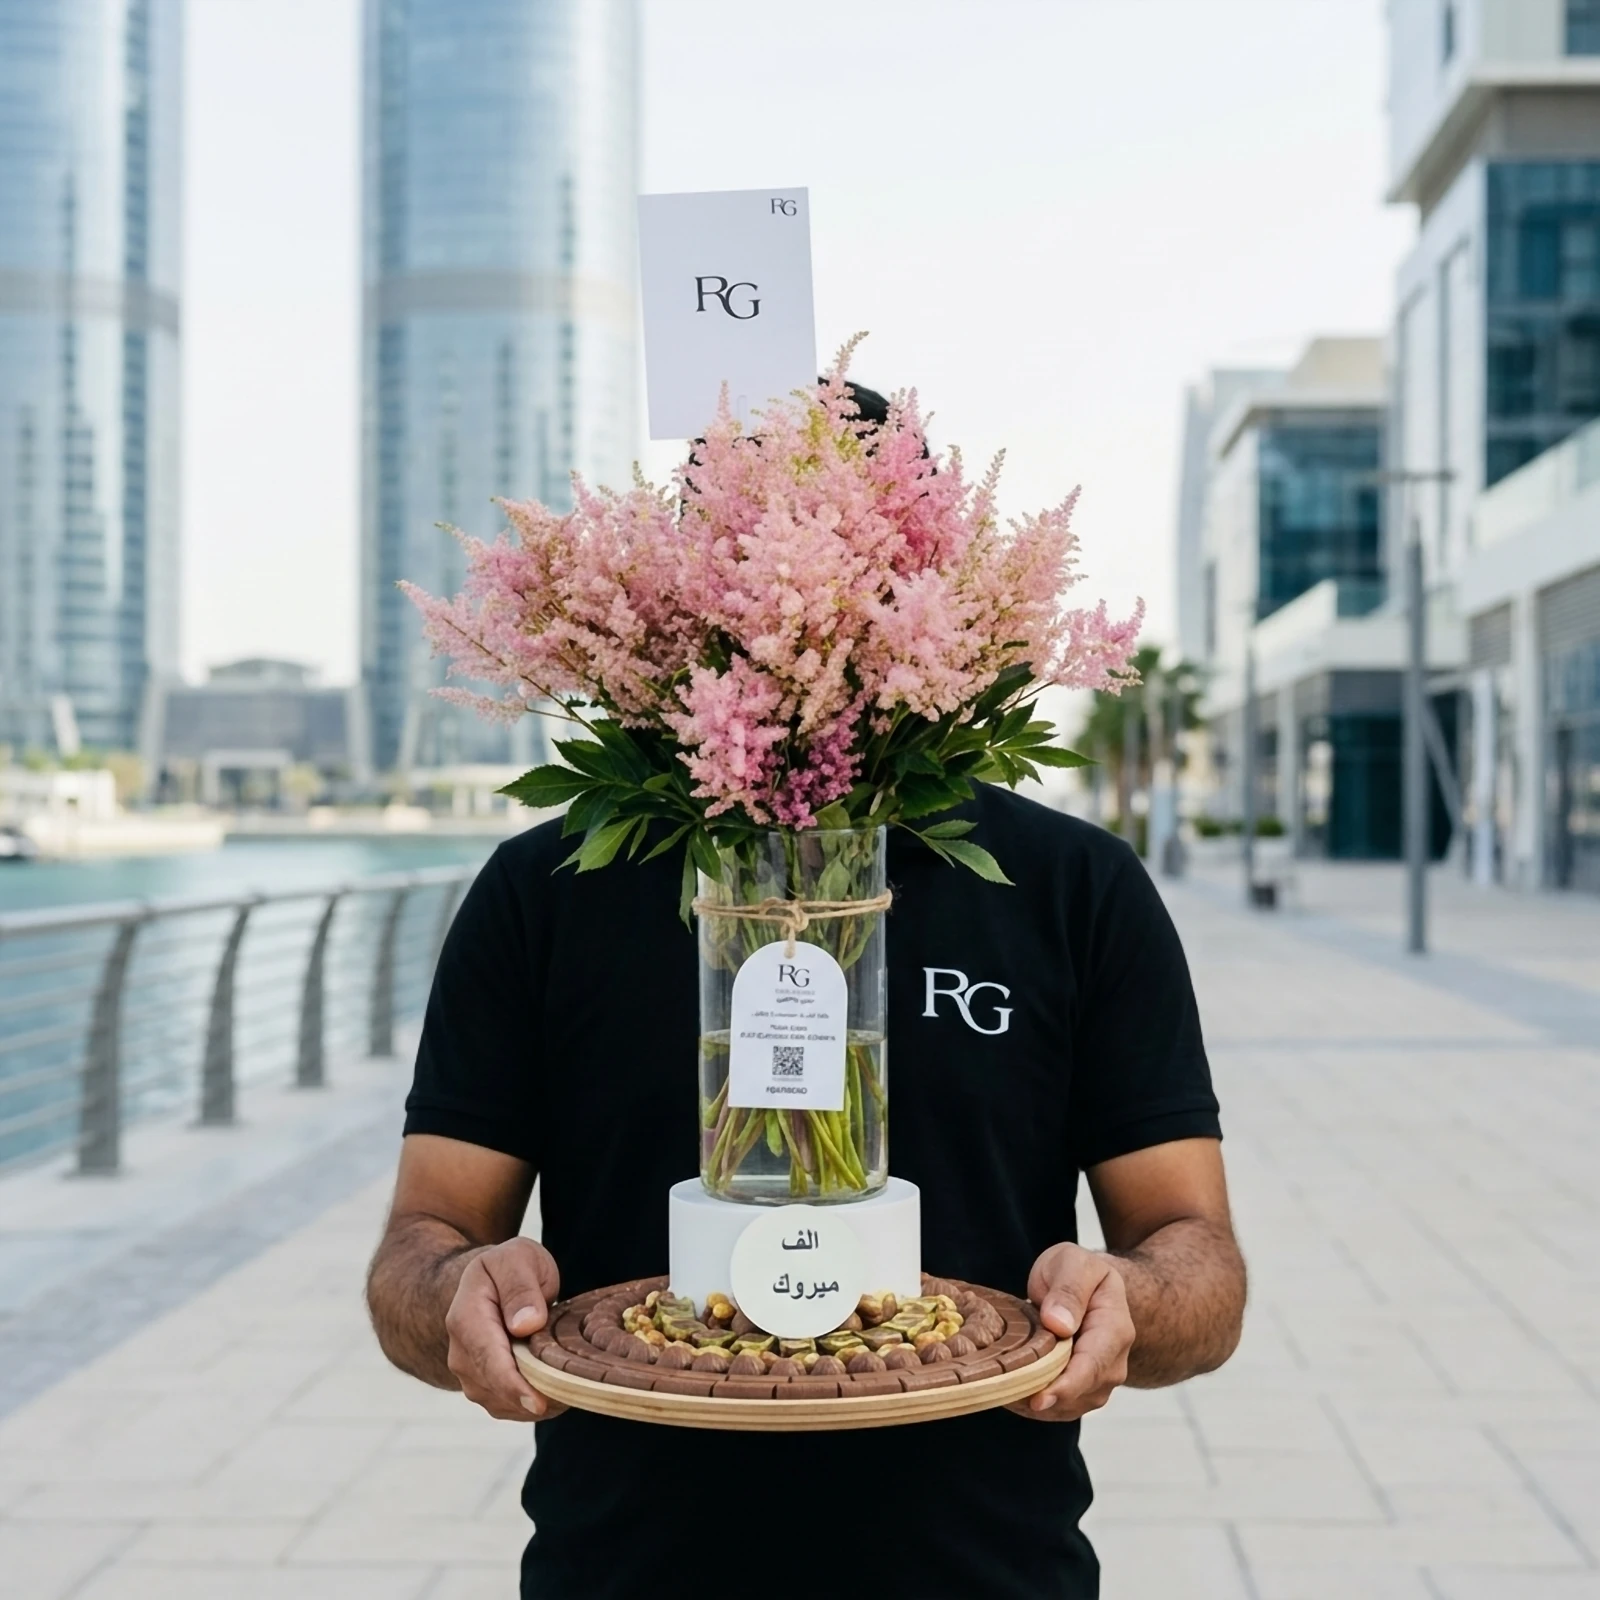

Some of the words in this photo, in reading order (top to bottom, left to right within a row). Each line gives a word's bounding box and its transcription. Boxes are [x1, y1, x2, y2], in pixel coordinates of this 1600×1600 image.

[770, 198, 797, 216] RG
[695, 276, 761, 320] RG
[778, 964, 810, 988] RG
[922, 967, 1014, 1035] RG
[781, 1228, 819, 1250] الف
